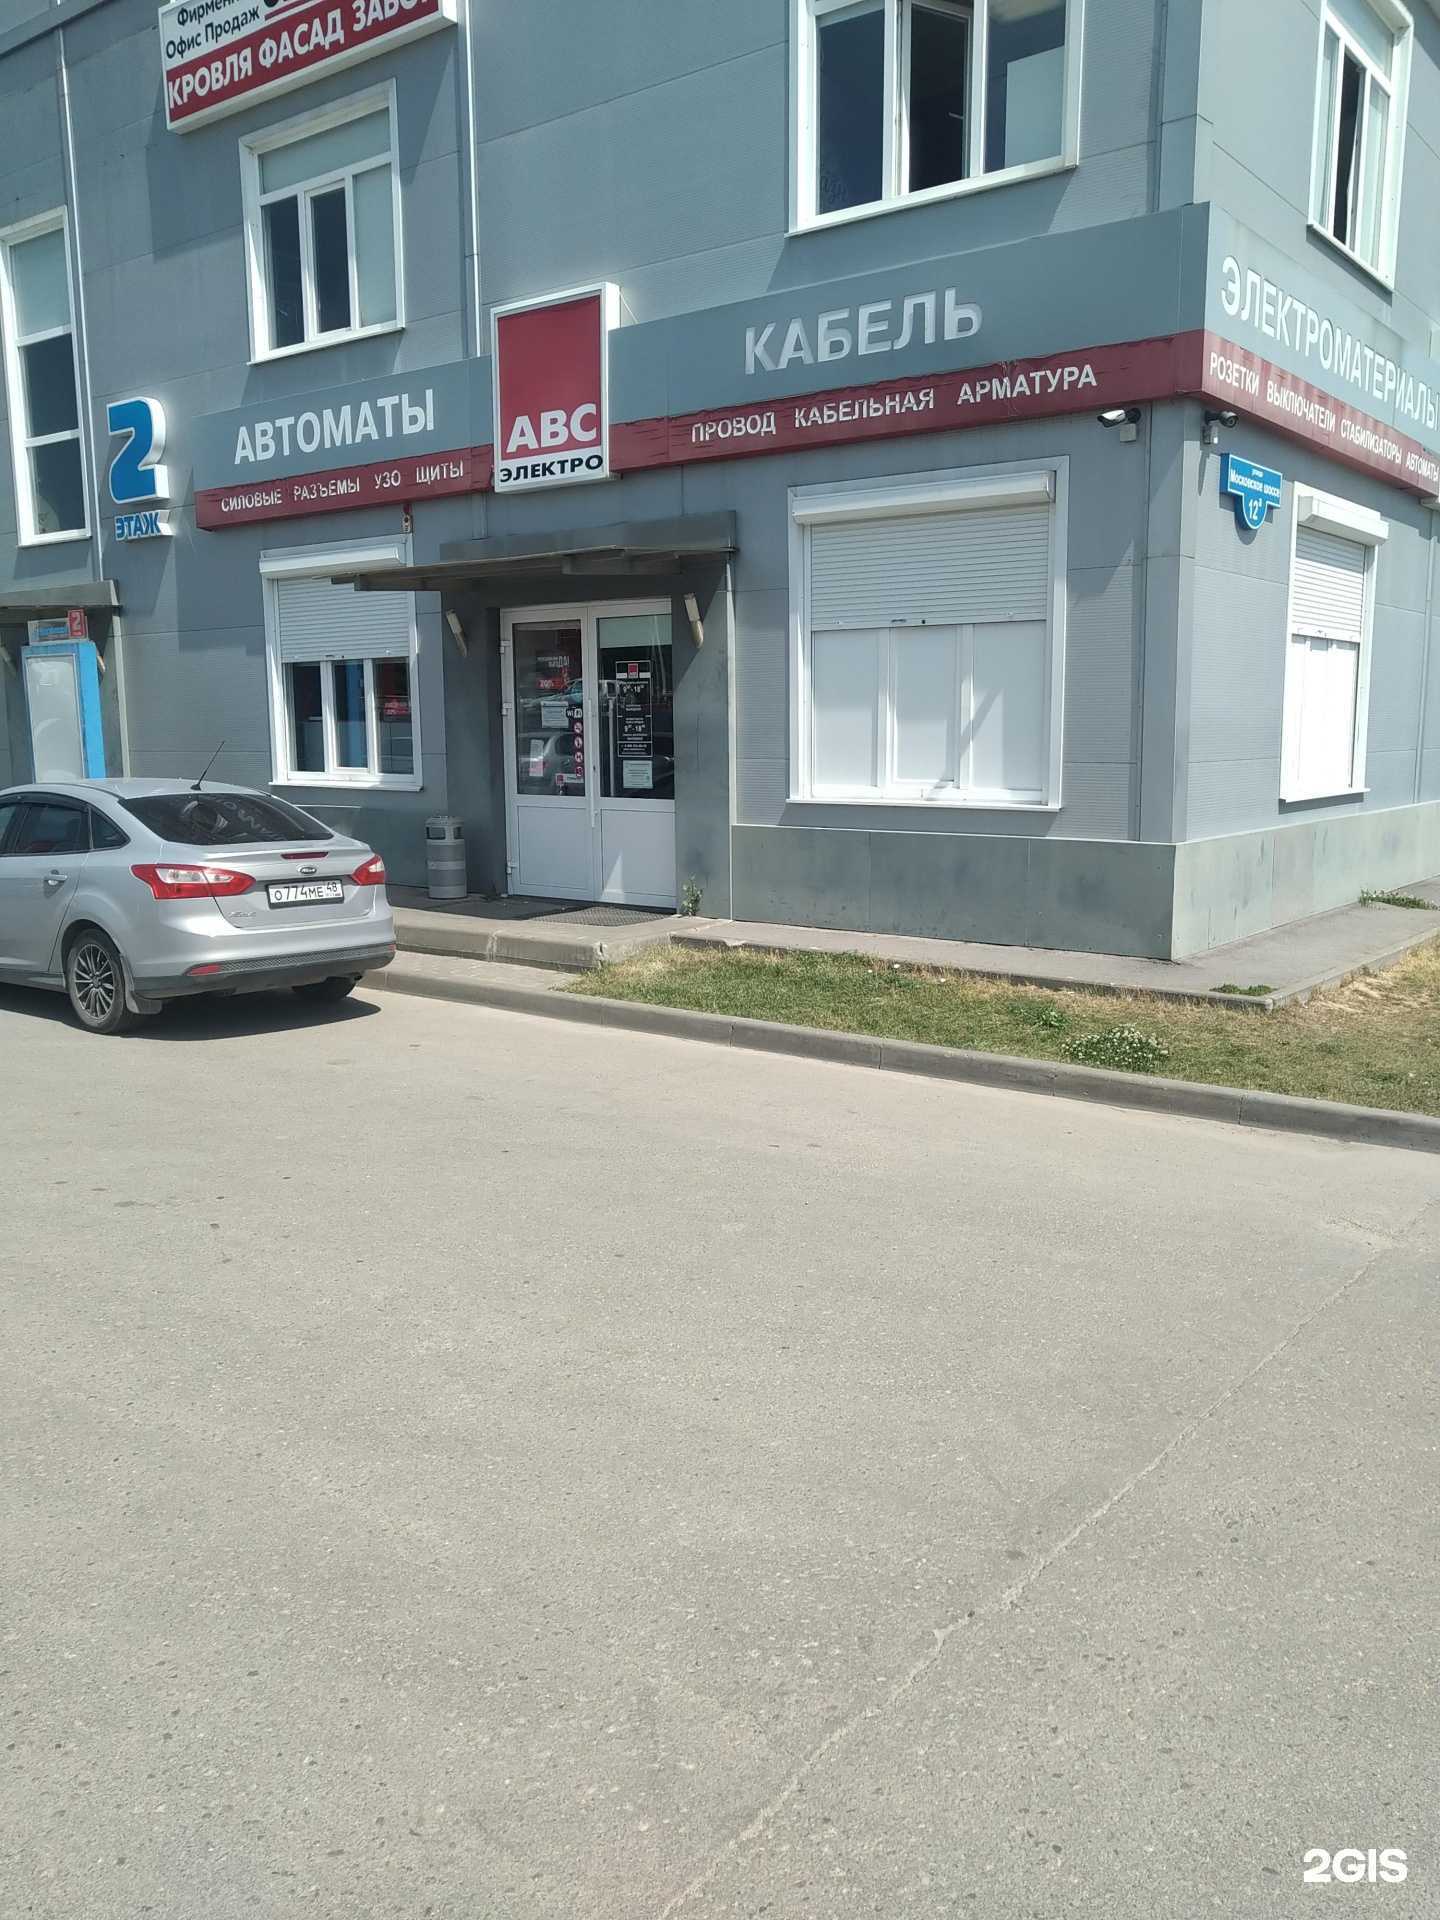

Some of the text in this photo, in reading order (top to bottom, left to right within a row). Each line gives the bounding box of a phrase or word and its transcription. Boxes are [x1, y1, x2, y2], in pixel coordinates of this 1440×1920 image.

[166, 6, 260, 59] Офис Продаж
[168, 47, 252, 109] КРОВЛЯ
[258, 8, 345, 68] ФАСАД
[744, 286, 983, 375] КАБЕЛЬ
[1221, 255, 1440, 432] ЭЛЕКТРОМАТЕРИАЛЫ
[234, 388, 436, 465] АВТОМАТЫ
[691, 364, 1098, 443] ПРОВОД КАБЕЛЬНАЯ АРМАТУРА
[1210, 352, 1440, 481] РОЗЕТКИ ВЫКЛЮЧАТЕЛИ СТАБИЛИЗАТОРЫ АВТОМАТЫ
[107, 396, 164, 503] 2
[221, 460, 465, 513] СИЛОВЫЕ РАЗЪЕМЫ УЗО ЩИТЫ
[500, 454, 603, 482] ЭЛЕКТРО
[115, 511, 163, 540] ЭТАЖ
